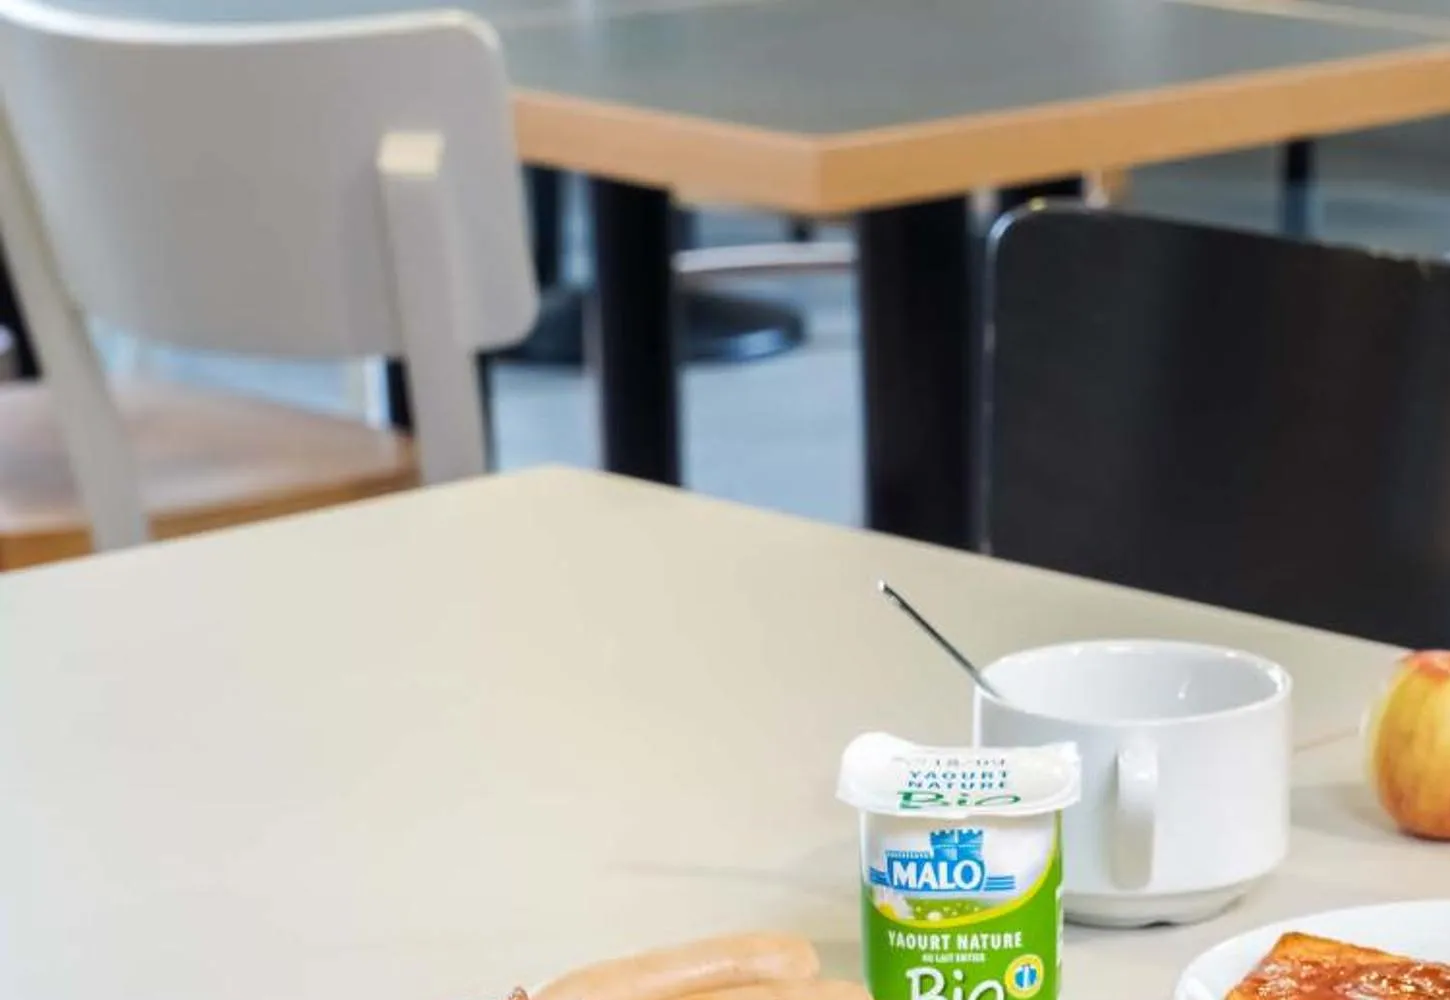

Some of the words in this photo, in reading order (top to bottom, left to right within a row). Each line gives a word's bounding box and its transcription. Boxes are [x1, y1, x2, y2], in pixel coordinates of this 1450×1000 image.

[909, 770, 1008, 780] YAOURT
[897, 790, 1021, 809] Bio
[893, 860, 982, 890] MALO
[888, 931, 950, 950] YAOURT
[957, 931, 1023, 950] NATURE
